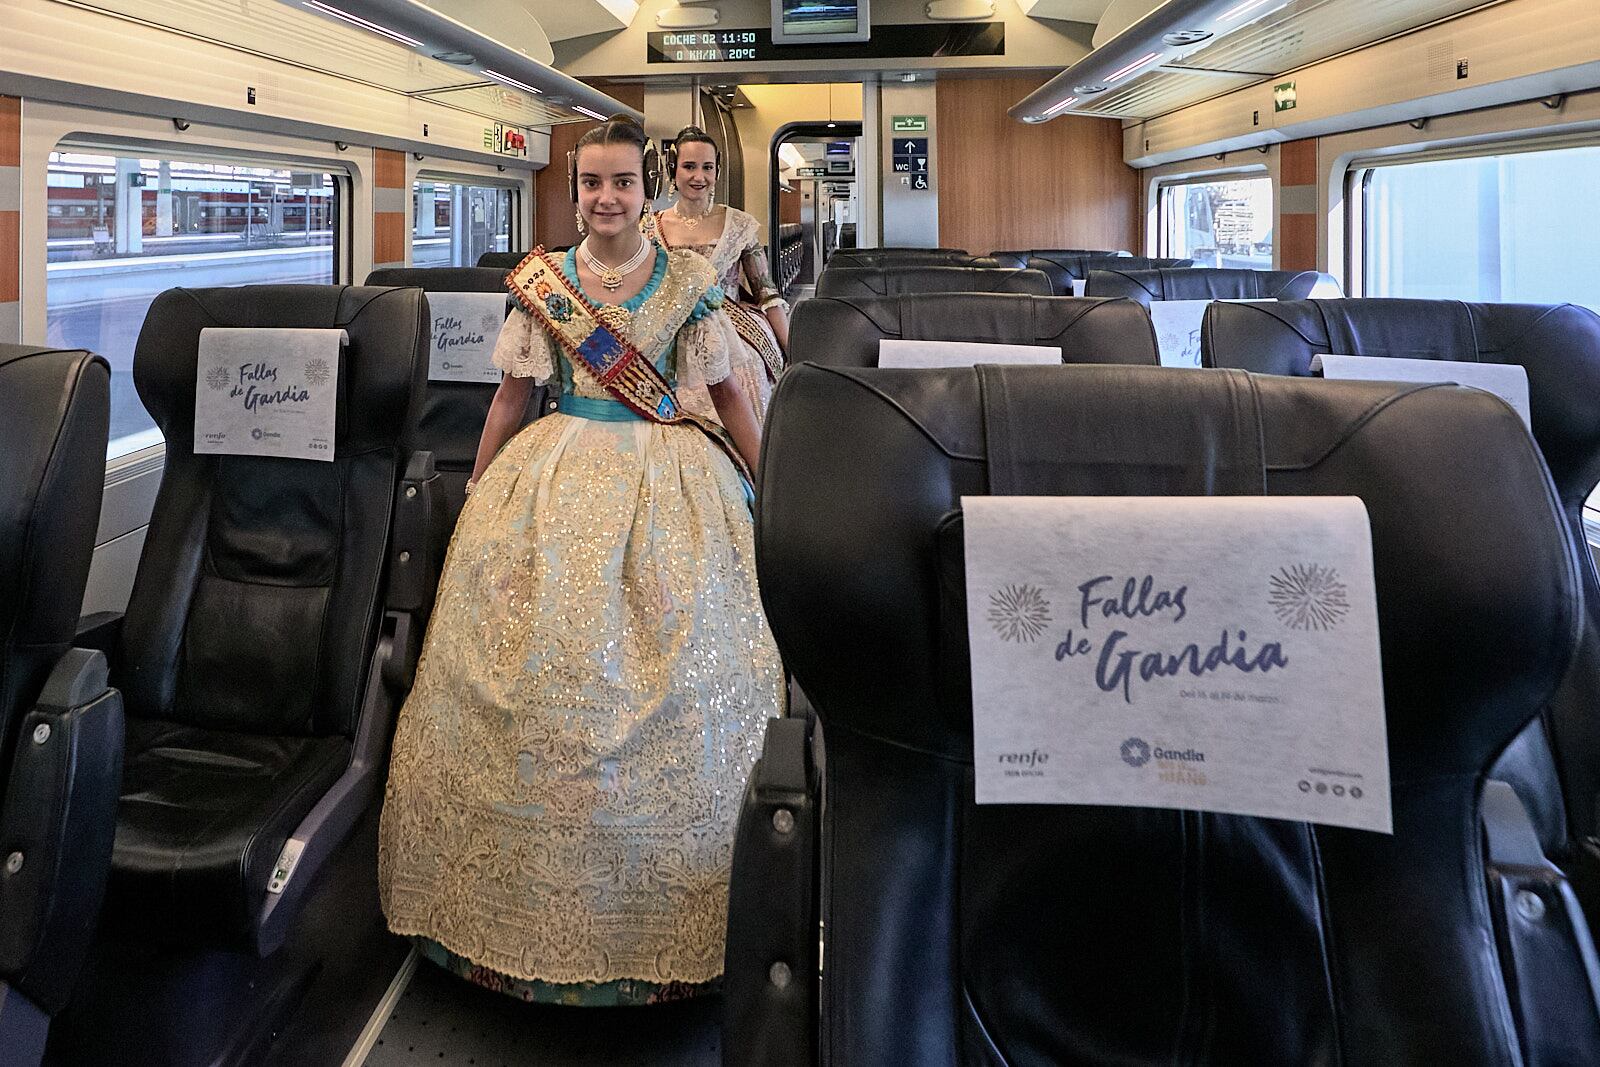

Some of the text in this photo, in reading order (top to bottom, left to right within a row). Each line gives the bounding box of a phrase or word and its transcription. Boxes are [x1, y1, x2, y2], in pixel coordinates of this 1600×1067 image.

[663, 33, 756, 45] COCHE 02 11:50
[676, 50, 683, 60] 0
[689, 49, 716, 60] KM/H
[435, 317, 462, 332] Fallas
[437, 332, 484, 352] Gandia
[239, 363, 278, 385] Fallas
[230, 384, 310, 415] de Gandia
[1077, 574, 1188, 629] Fallas
[1055, 629, 1289, 704] de Gandia
[998, 749, 1049, 768] renfe
[1153, 746, 1206, 762] Gandia
